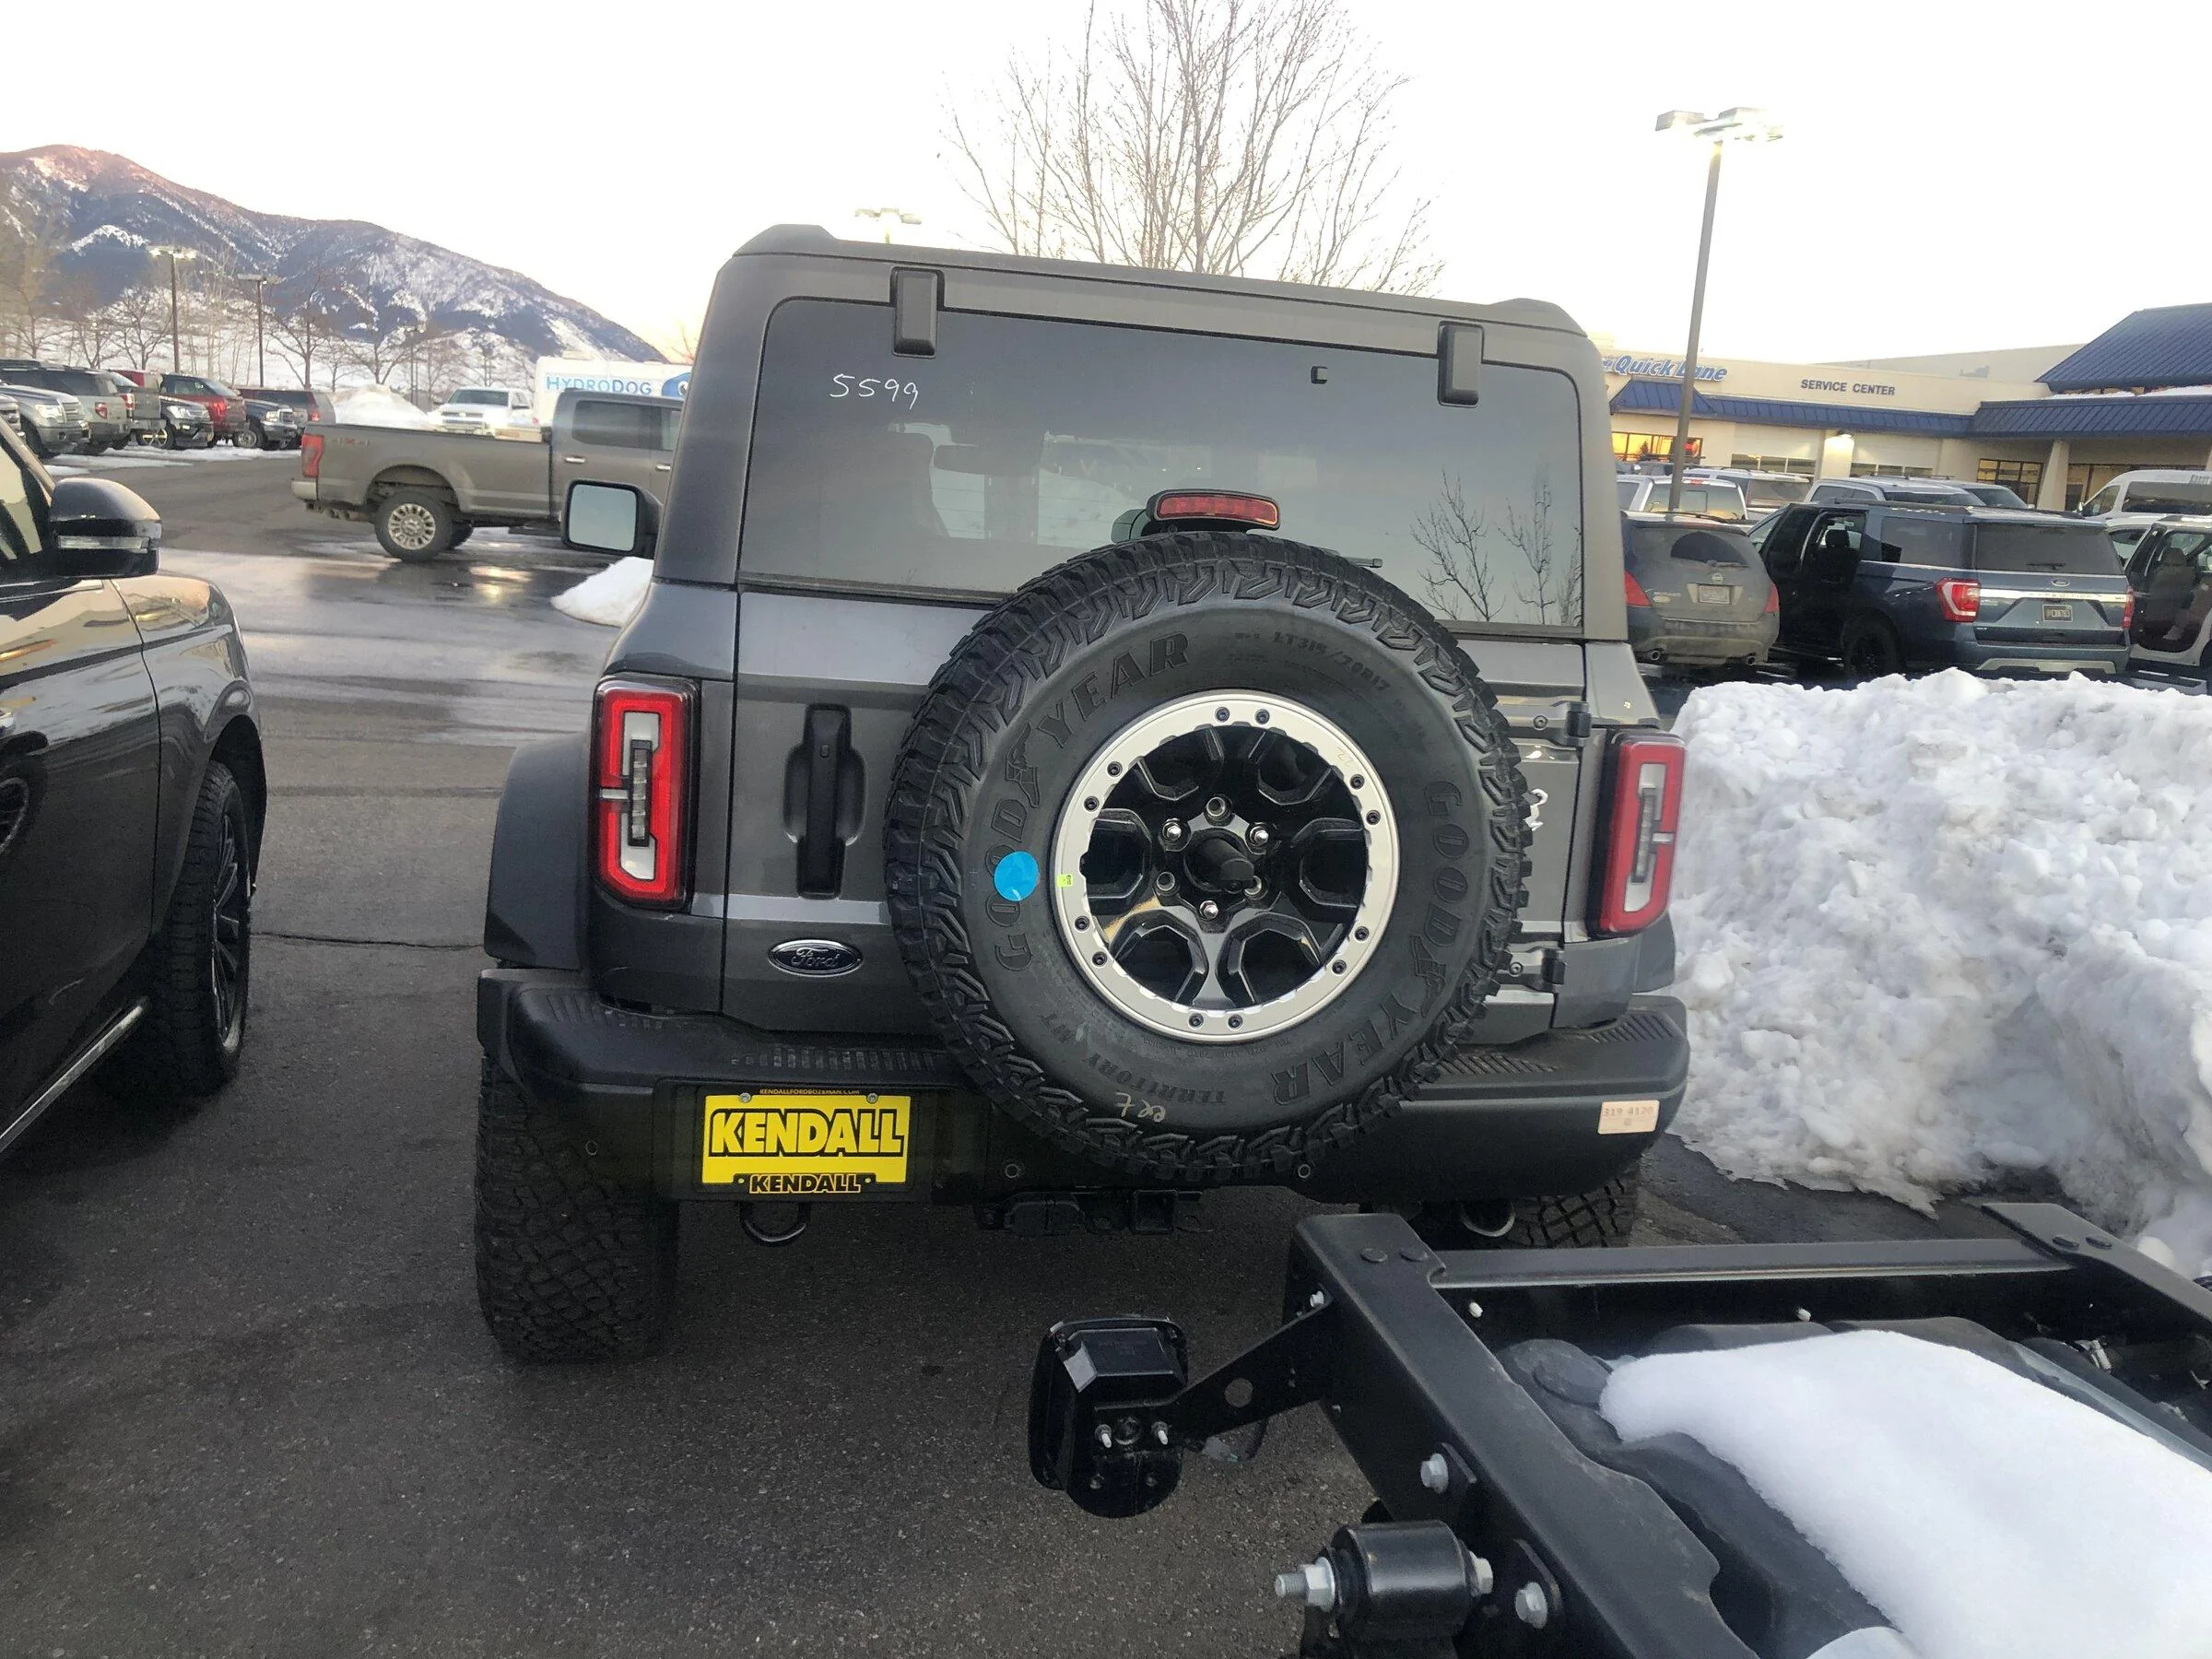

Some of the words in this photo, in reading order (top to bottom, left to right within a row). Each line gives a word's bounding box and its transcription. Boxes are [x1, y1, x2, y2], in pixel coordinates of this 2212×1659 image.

[1614, 354, 1676, 376] Quick
[546, 376, 653, 395] HYDRODOG
[830, 373, 919, 410] 5599
[1801, 379, 1848, 393] SERVICE
[1853, 382, 1896, 396] CENTER
[1085, 1052, 1227, 1104] TERRITORY
[708, 1108, 905, 1158] KENDALL
[748, 1173, 862, 1194] KENDALL
